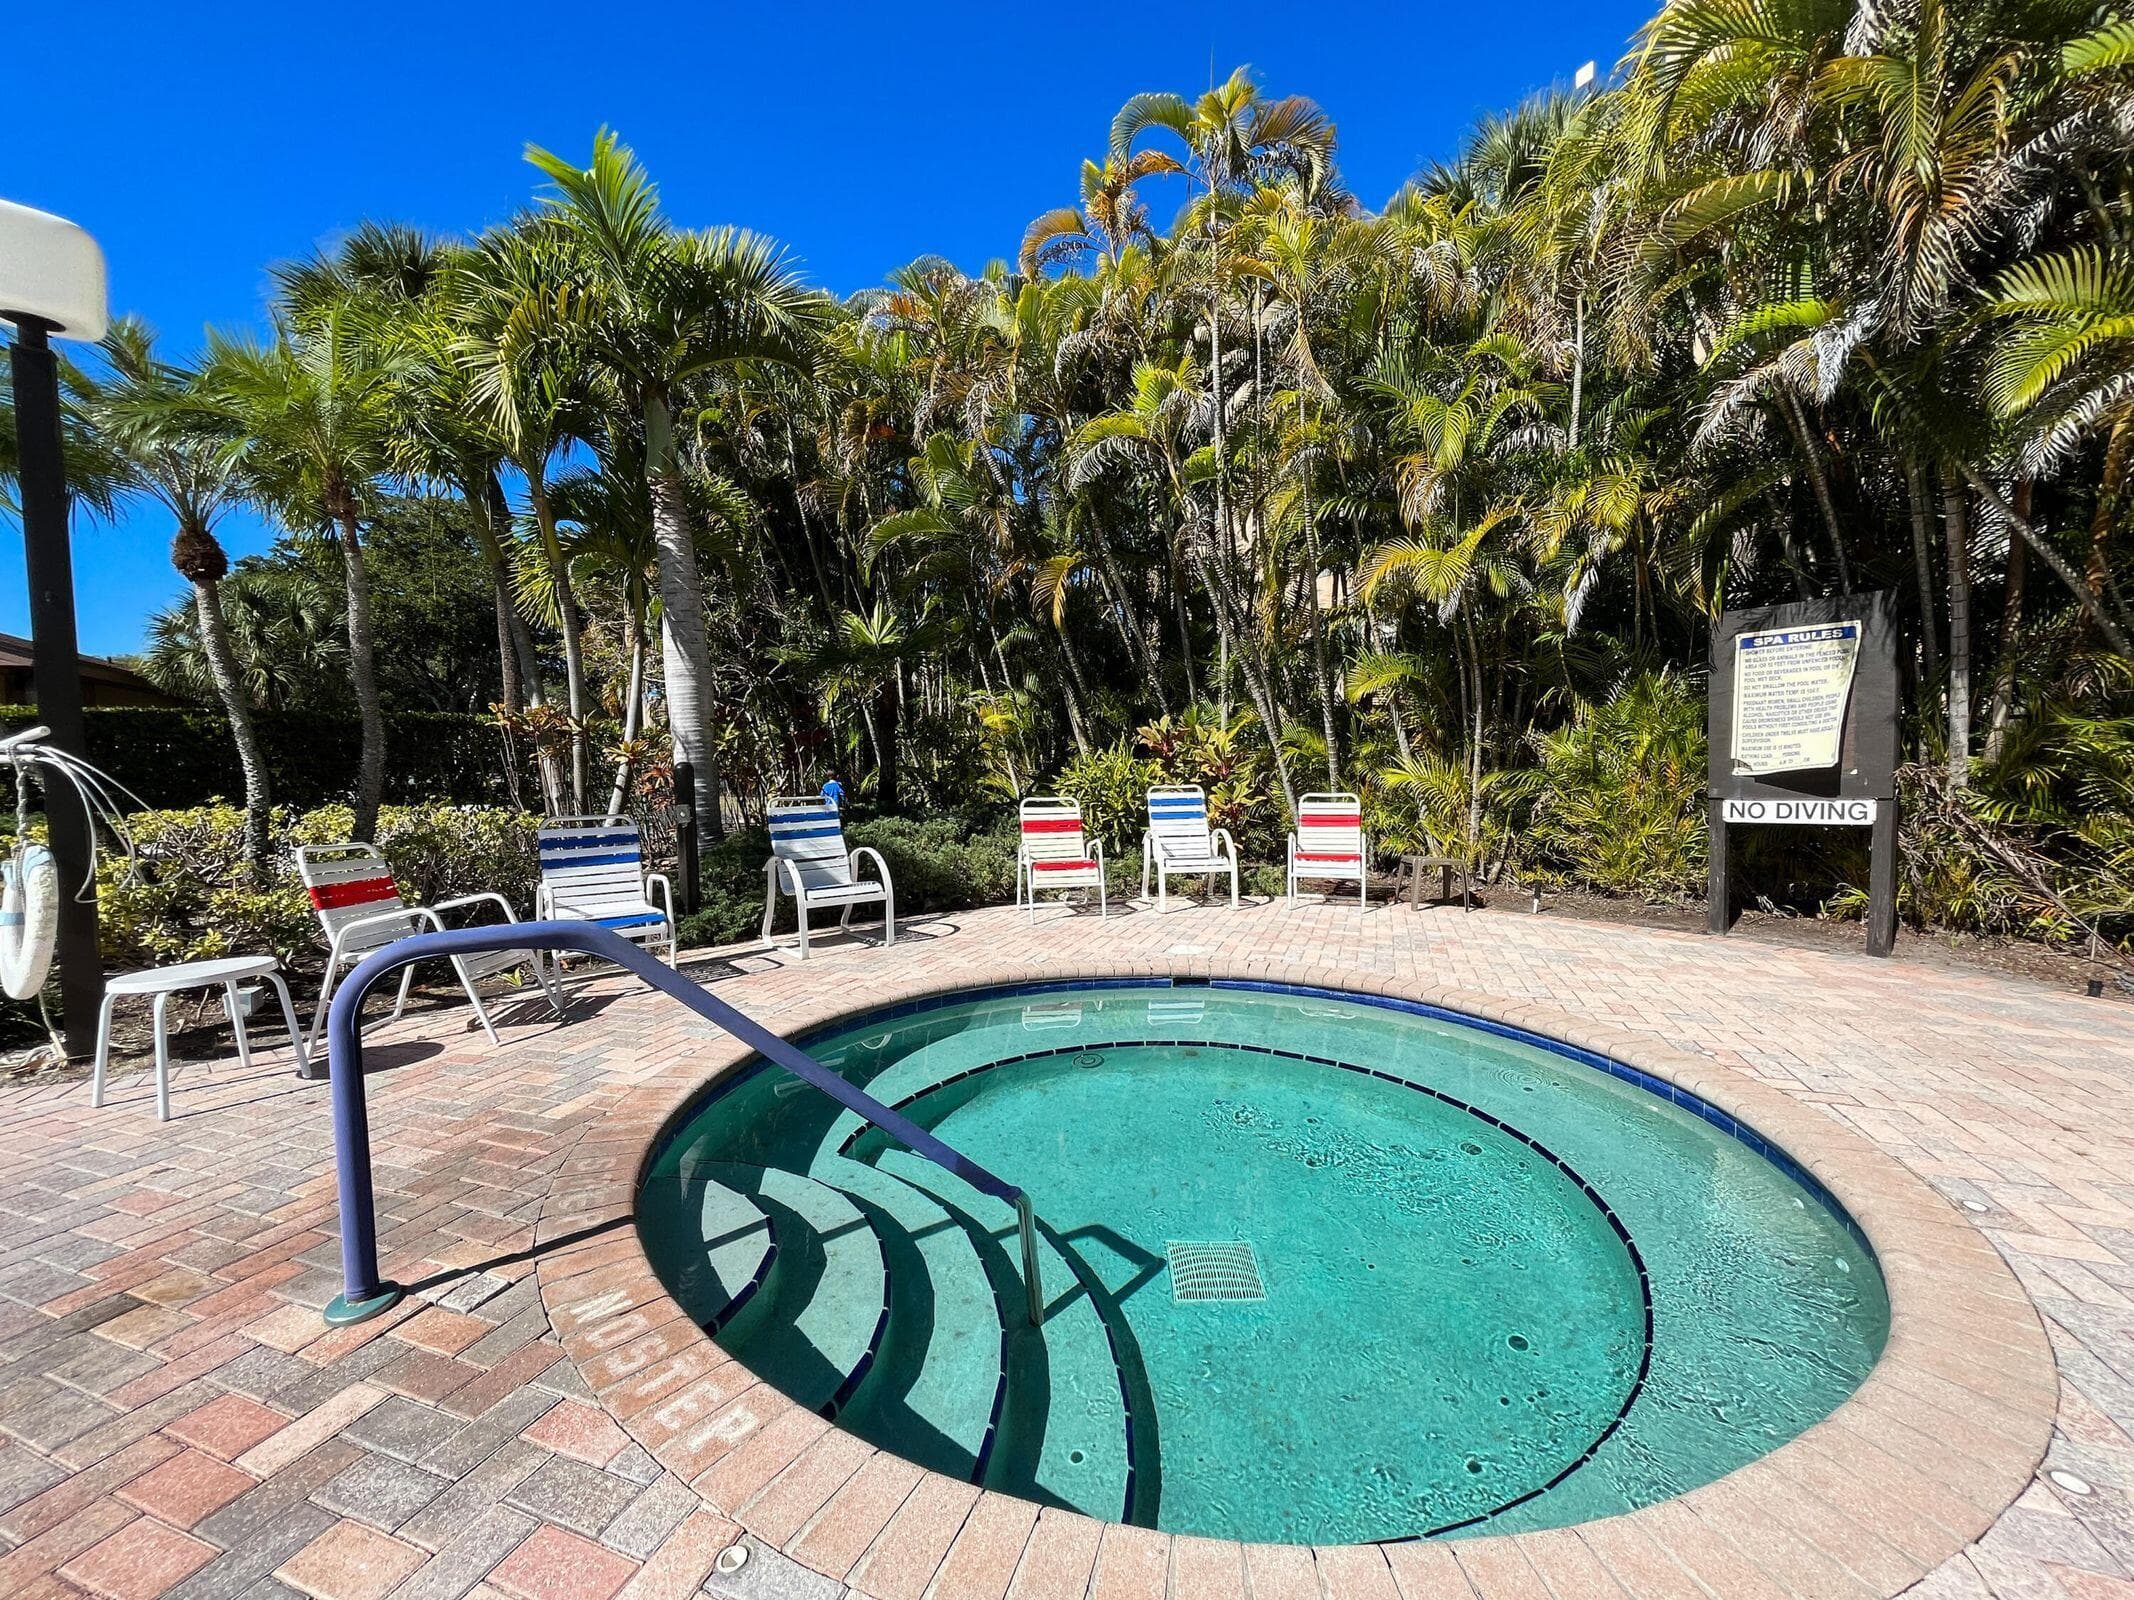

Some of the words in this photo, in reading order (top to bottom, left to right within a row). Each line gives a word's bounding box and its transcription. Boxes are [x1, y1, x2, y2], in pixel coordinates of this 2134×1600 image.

[1753, 635, 1784, 647] SPA
[1788, 629, 1843, 642] RULES
[1729, 802, 1766, 819] NO
[1776, 802, 1868, 821] DIVING
[570, 1290, 649, 1348] NO
[605, 1334, 759, 1453] STEP
